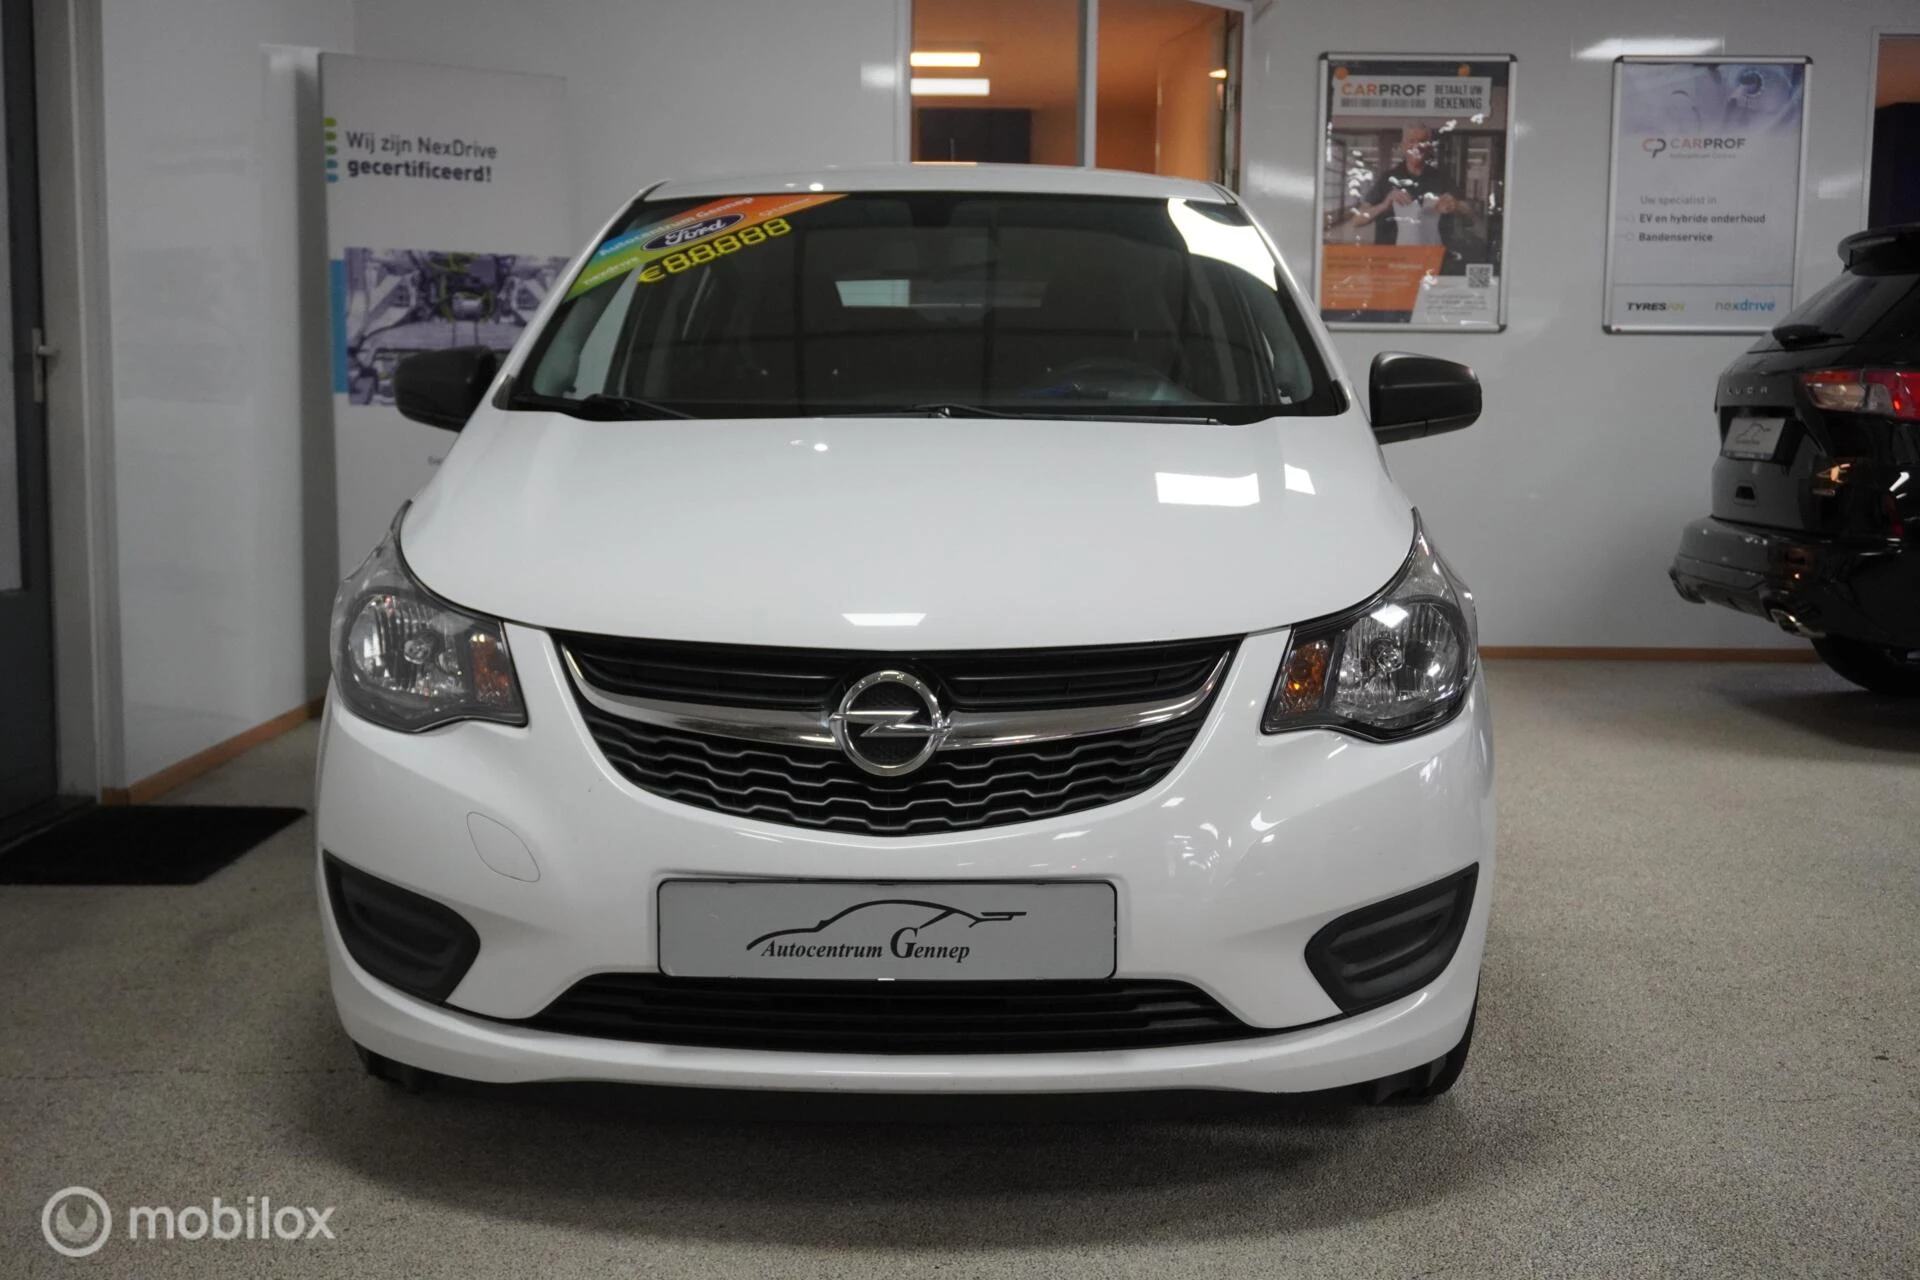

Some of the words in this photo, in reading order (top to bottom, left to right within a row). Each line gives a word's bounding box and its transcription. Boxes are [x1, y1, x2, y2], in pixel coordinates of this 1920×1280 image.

[1342, 83, 1427, 97] CARPROF
[346, 131, 375, 154] Wij
[381, 134, 412, 156] zijn
[417, 137, 498, 160] NexDrive
[1670, 138, 1746, 149] CARPROF
[347, 159, 493, 183] gecertificeerd!
[1658, 195, 1705, 207] specialist
[1707, 195, 1717, 205] in
[1640, 214, 1652, 224] EV
[1655, 216, 1667, 224] en
[1670, 213, 1709, 226] hybride
[1711, 213, 1766, 224] onderhoud
[664, 219, 728, 246] Ford
[1639, 232, 1713, 242] Bandenservice
[760, 940, 882, 958] Autocentrum
[890, 926, 970, 963] Gennep
